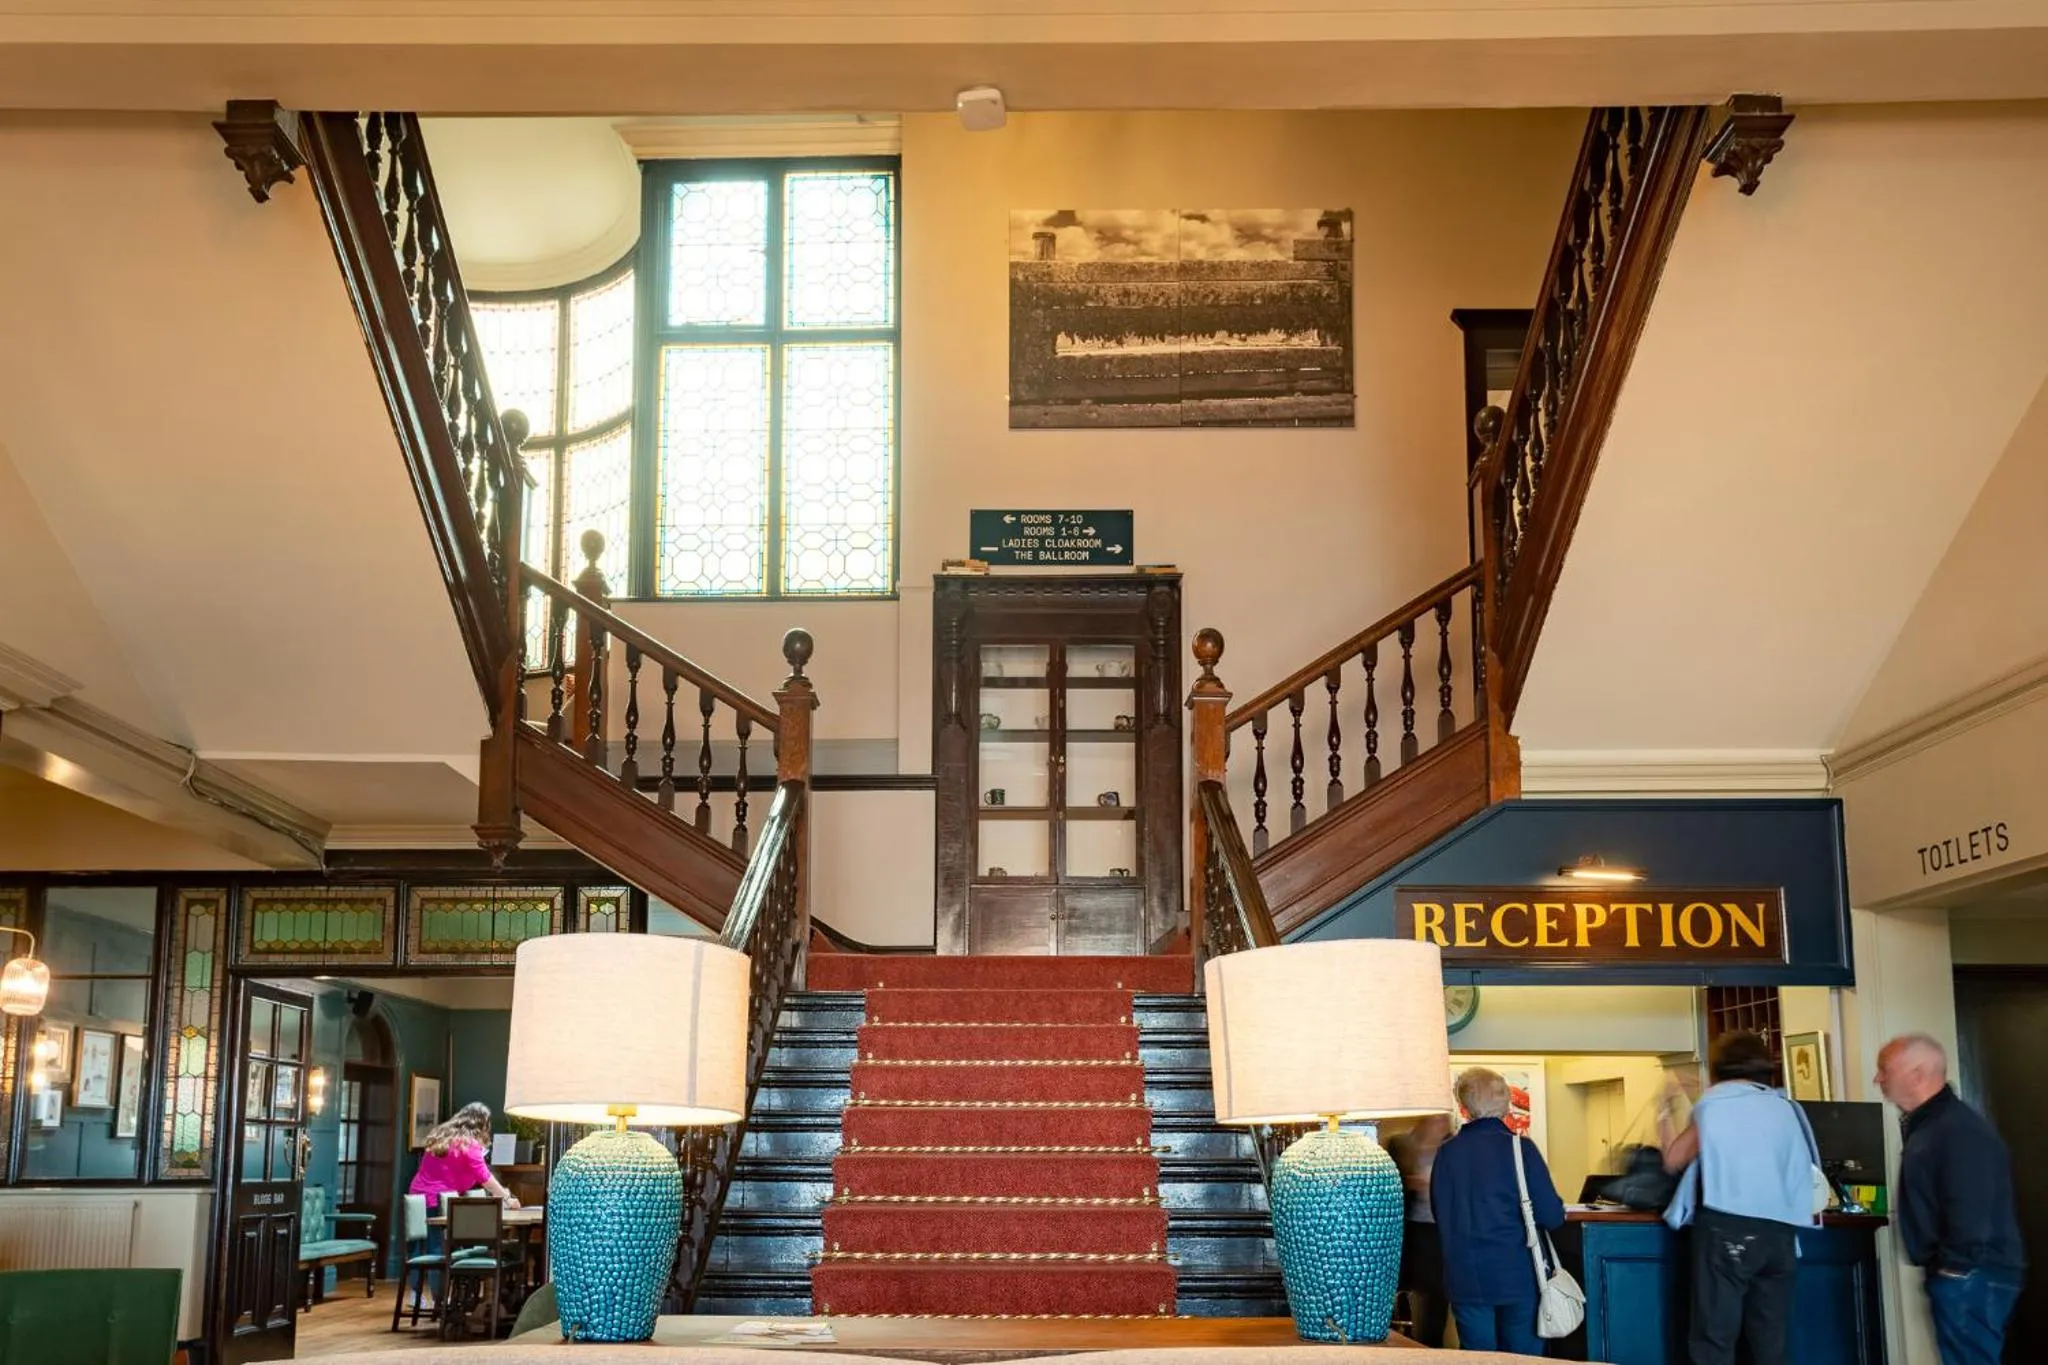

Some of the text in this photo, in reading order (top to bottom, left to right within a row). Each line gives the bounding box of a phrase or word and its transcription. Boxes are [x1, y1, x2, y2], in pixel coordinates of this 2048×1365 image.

[1020, 514, 1083, 524] ROOMS 7-10
[1024, 526, 1055, 536] ROOMS
[1002, 538, 1102, 548] LADIES CLOAKROOM
[1015, 550, 1089, 560] THE BALLROOM
[1917, 822, 2009, 875] TOILETS
[1411, 903, 1765, 948] RECEPTION
